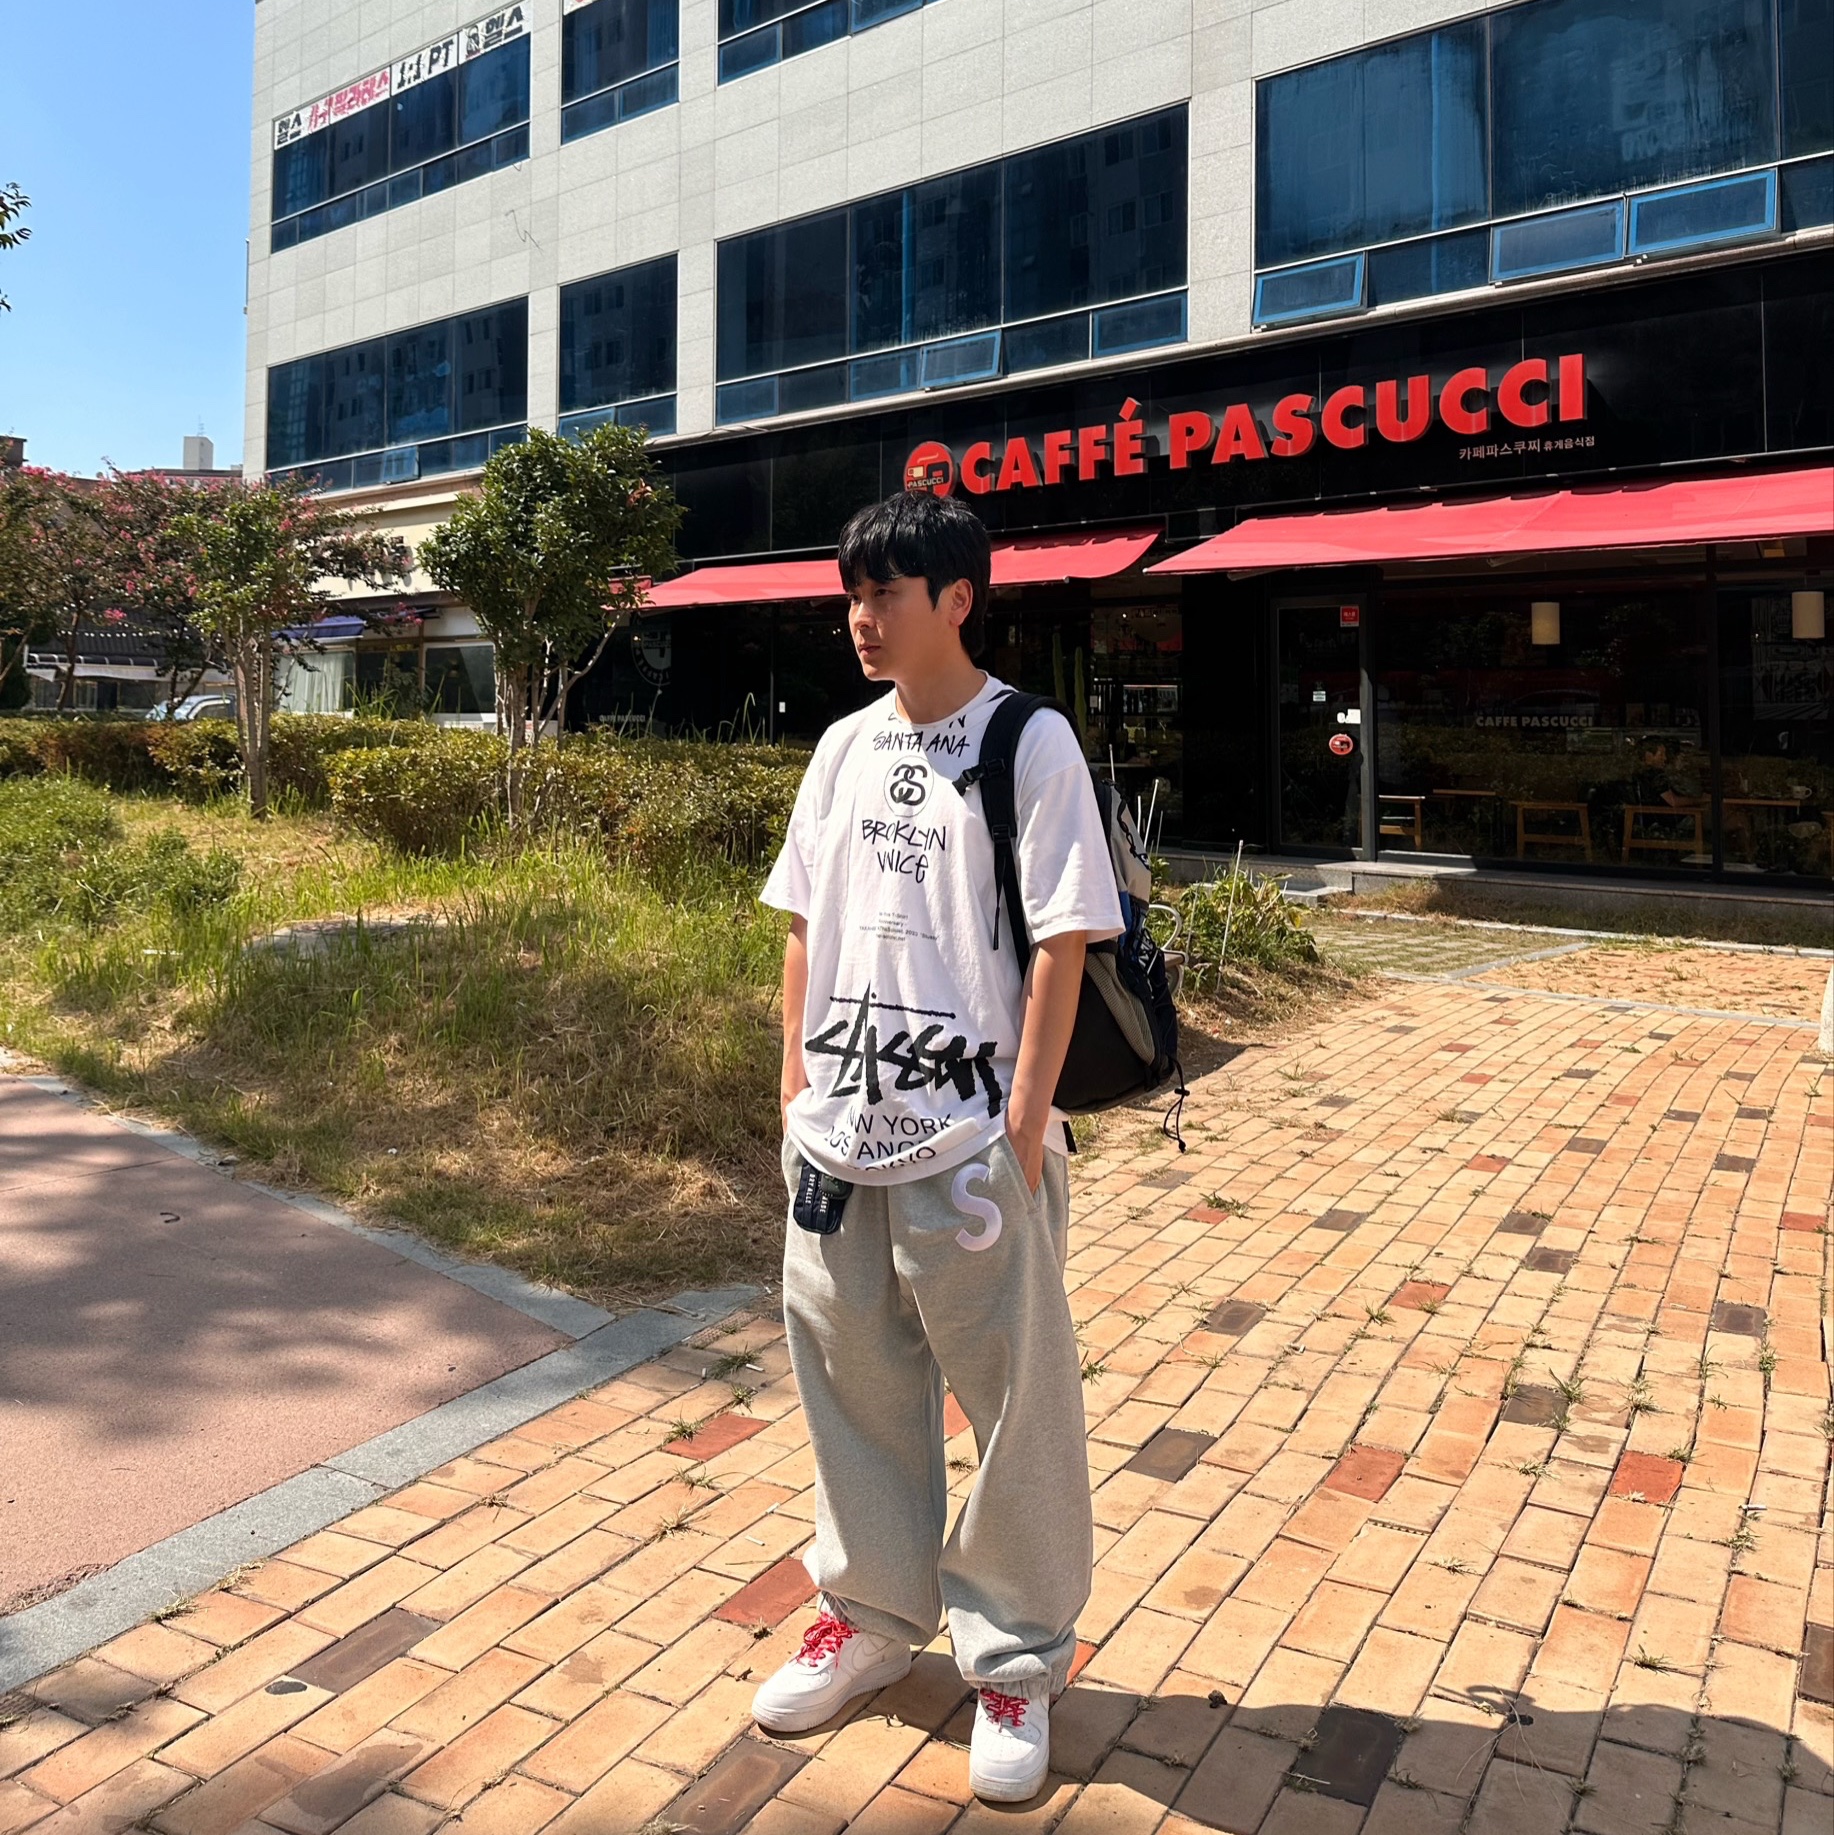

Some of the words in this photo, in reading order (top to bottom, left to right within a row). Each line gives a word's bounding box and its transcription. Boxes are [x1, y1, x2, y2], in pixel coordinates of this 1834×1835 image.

[427, 38, 454, 75] PT
[960, 396, 1146, 495] CAFFÉ
[1168, 353, 1586, 470] PASCUCCI
[1458, 439, 1541, 460] 카페파스쿠찌
[1543, 436, 1596, 451] 휴게음식점
[1476, 715, 1518, 727] CAFFE
[1521, 715, 1593, 727] PASCUCCI
[873, 731, 924, 753] SANTA
[926, 733, 970, 757] ANA
[882, 1113, 952, 1136] YORK
